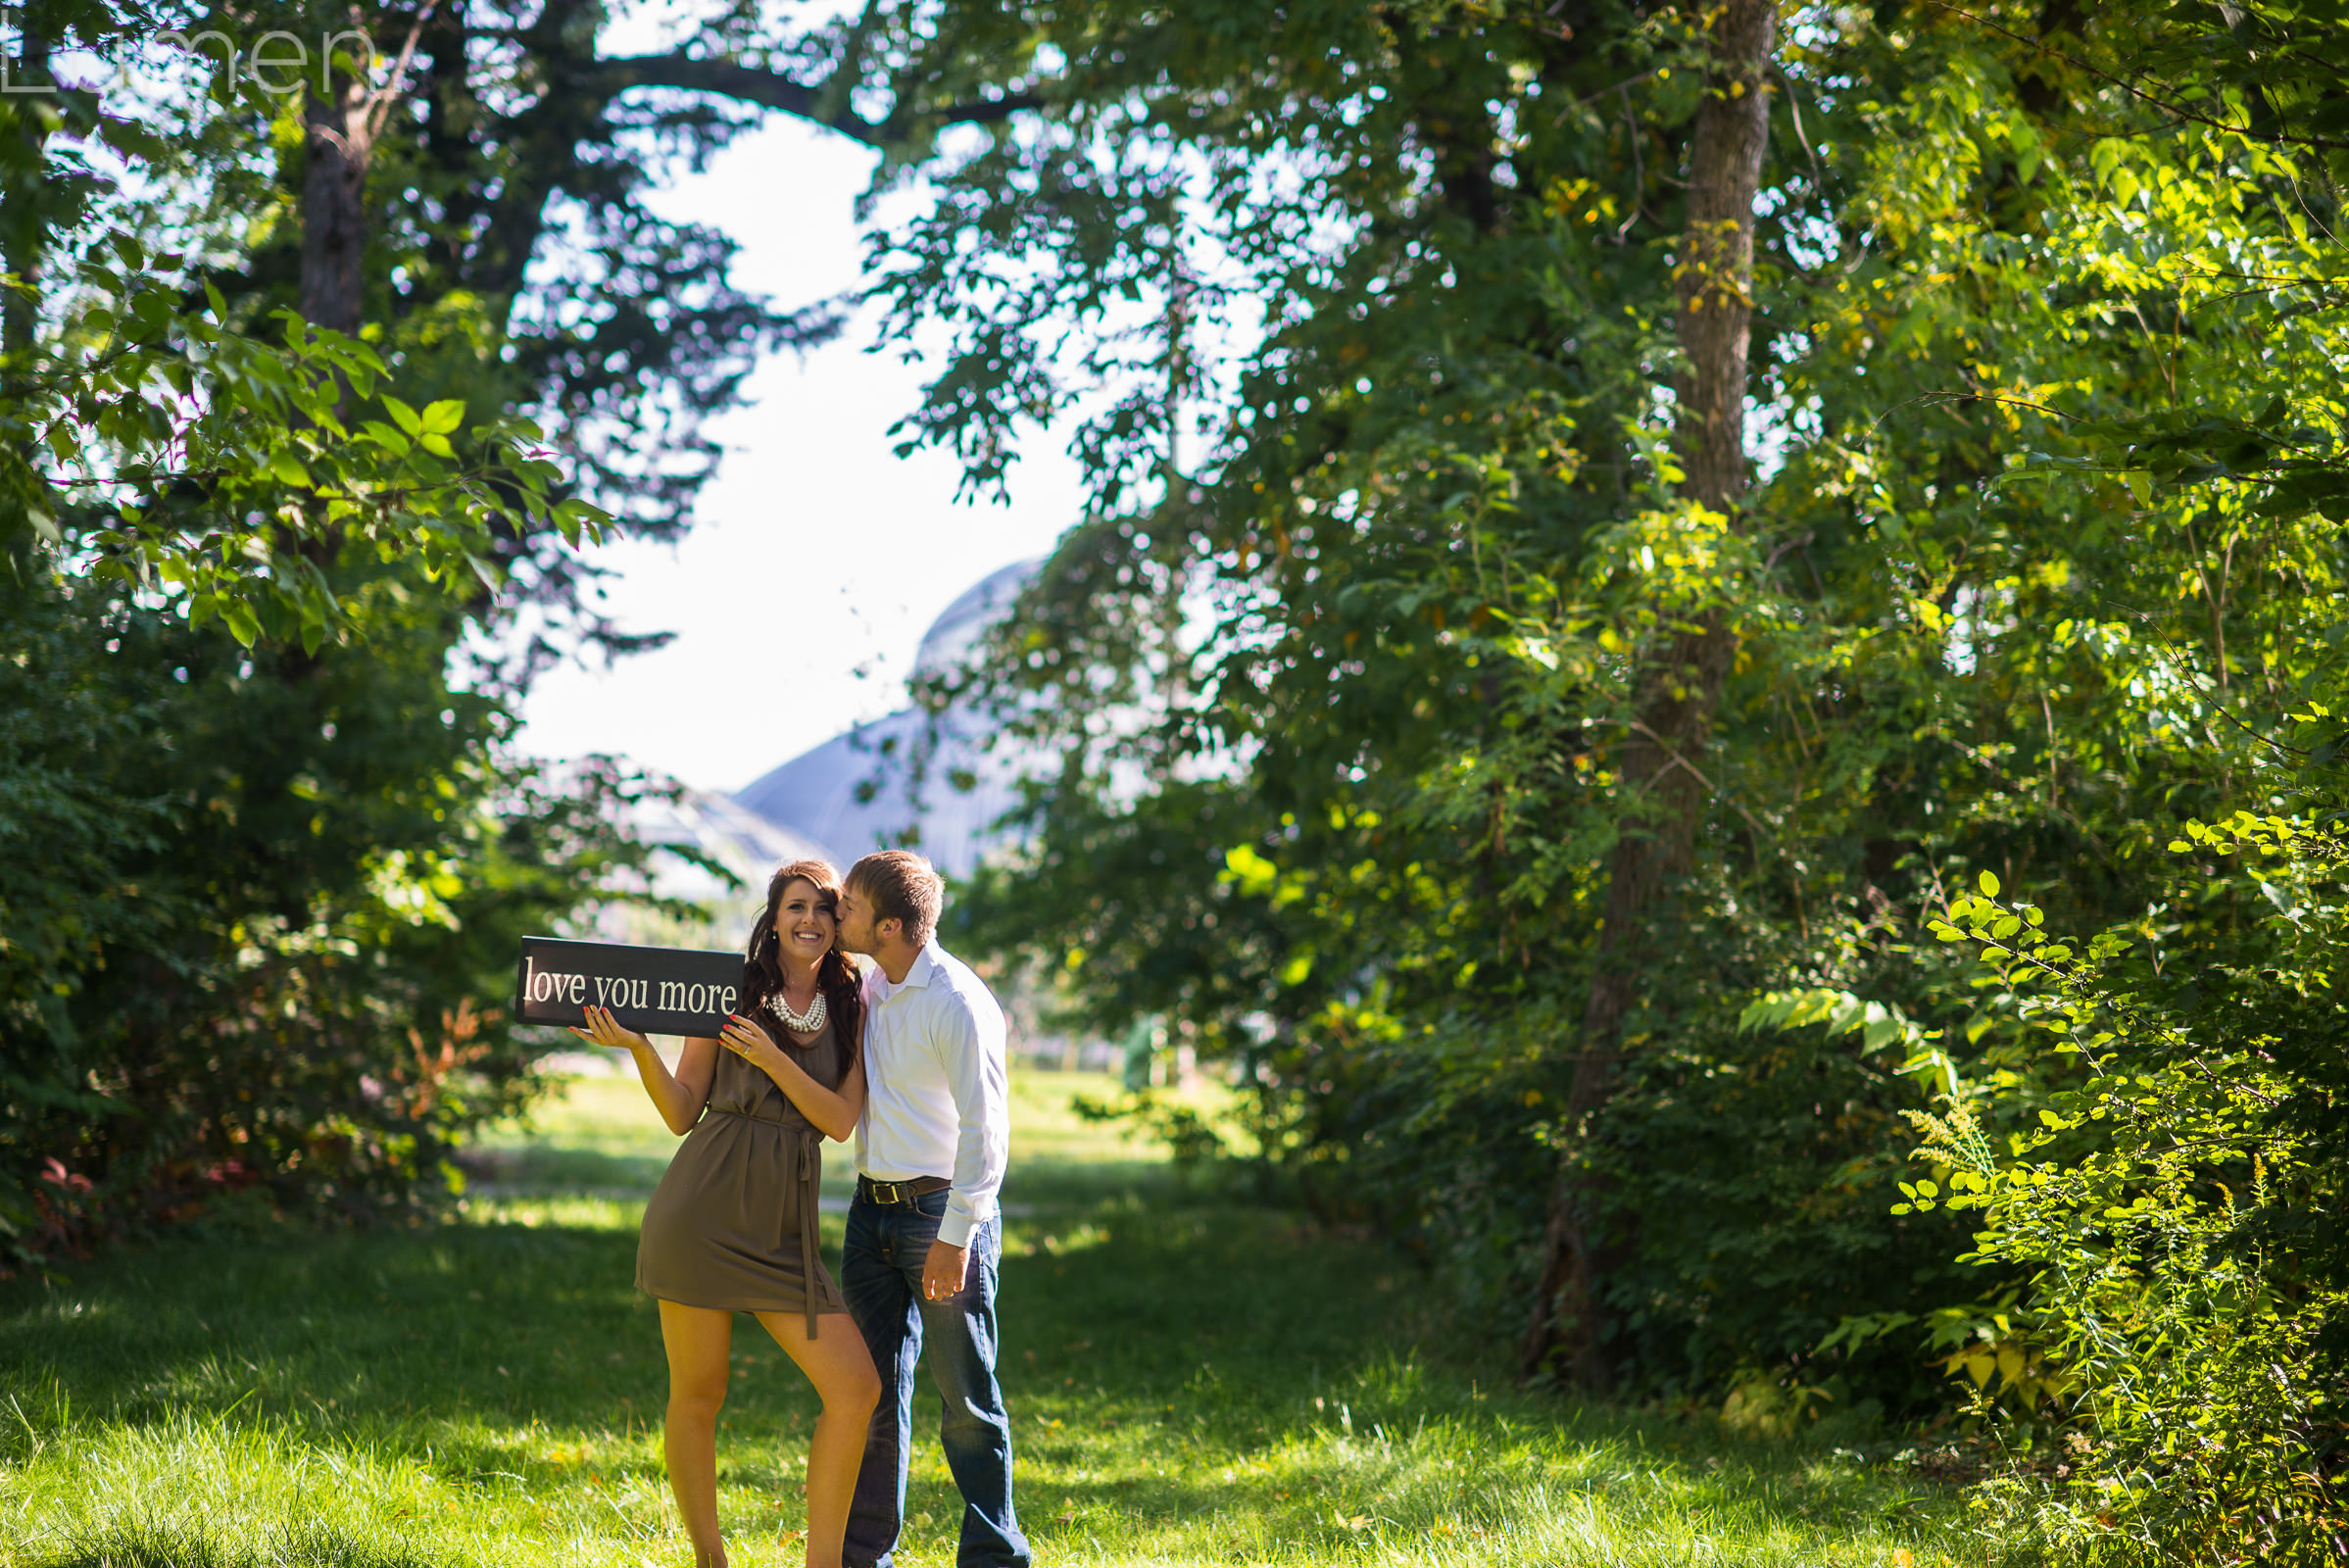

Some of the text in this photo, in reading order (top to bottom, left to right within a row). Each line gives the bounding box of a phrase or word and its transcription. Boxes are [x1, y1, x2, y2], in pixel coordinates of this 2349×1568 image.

[522, 956, 737, 1015] love you more
